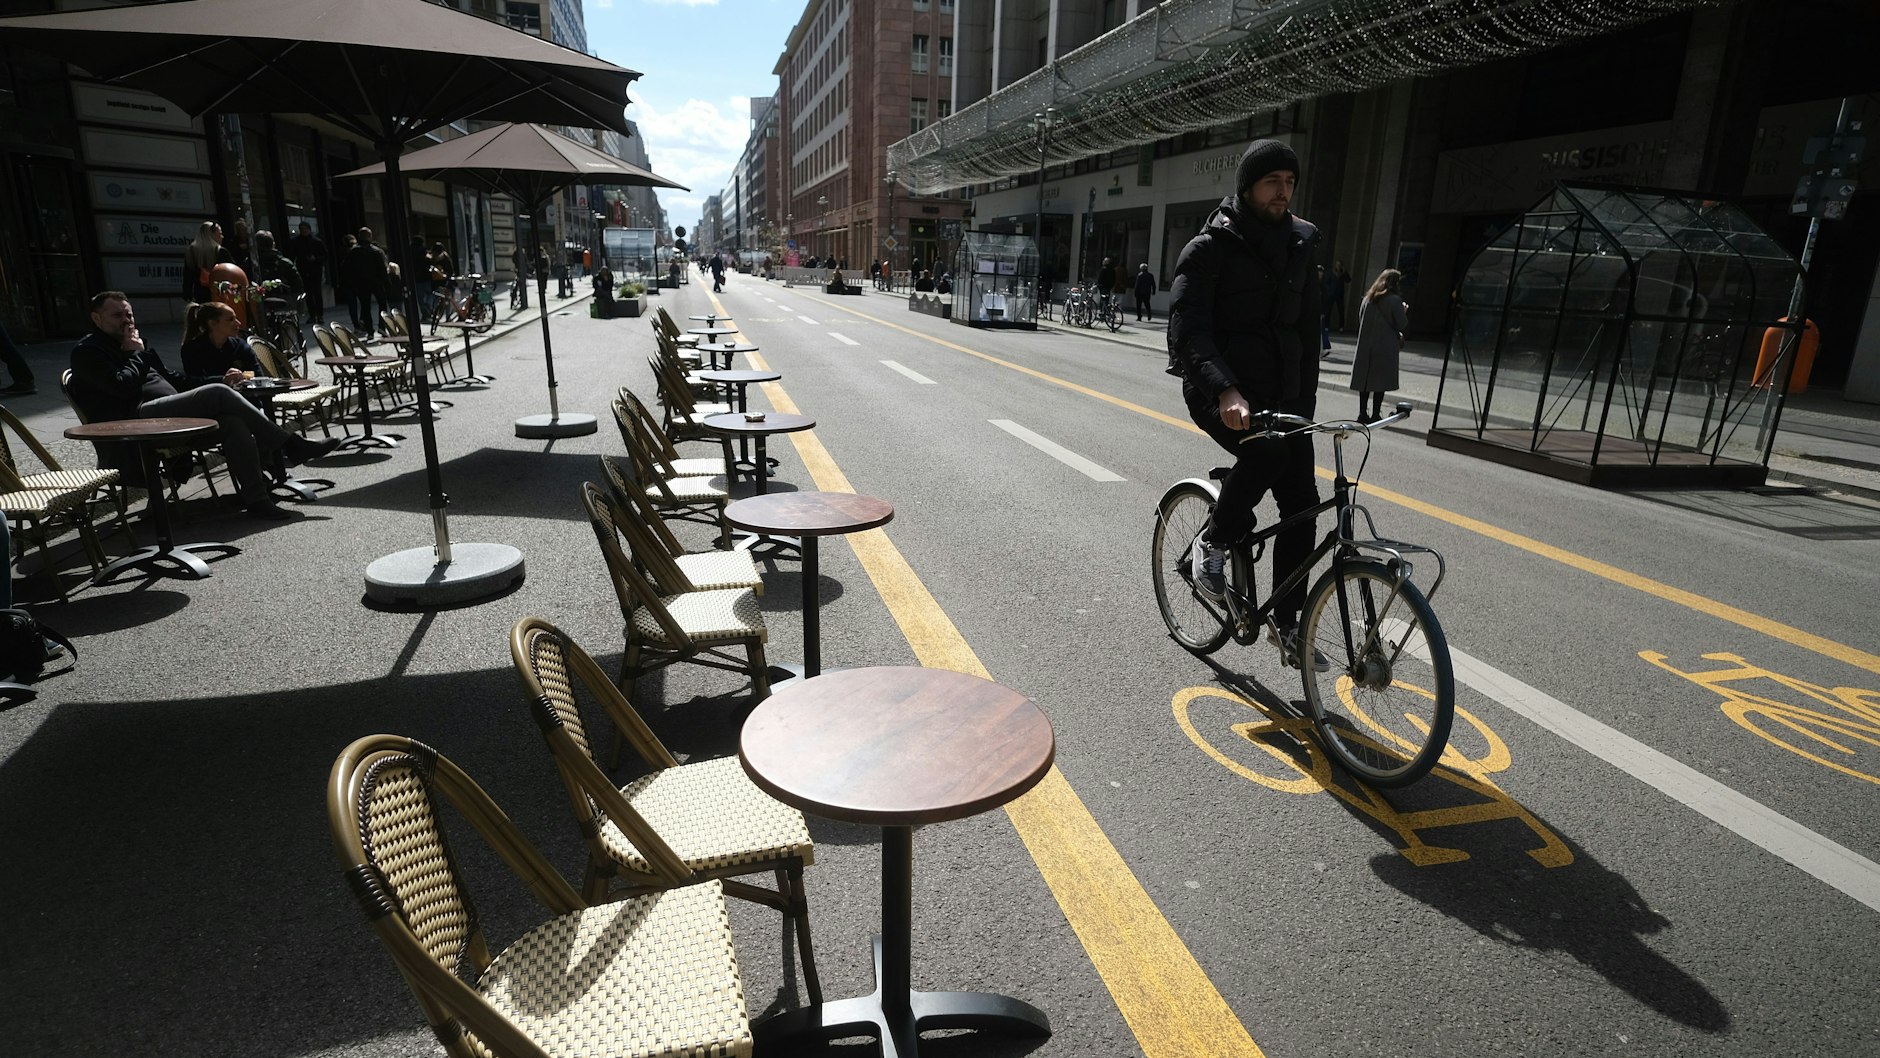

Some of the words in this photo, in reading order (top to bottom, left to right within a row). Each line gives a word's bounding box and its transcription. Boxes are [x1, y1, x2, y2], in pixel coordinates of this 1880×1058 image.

[1193, 154, 1242, 175] BUCHERER
[141, 223, 159, 234] Die
[164, 266, 184, 278] AGAI
